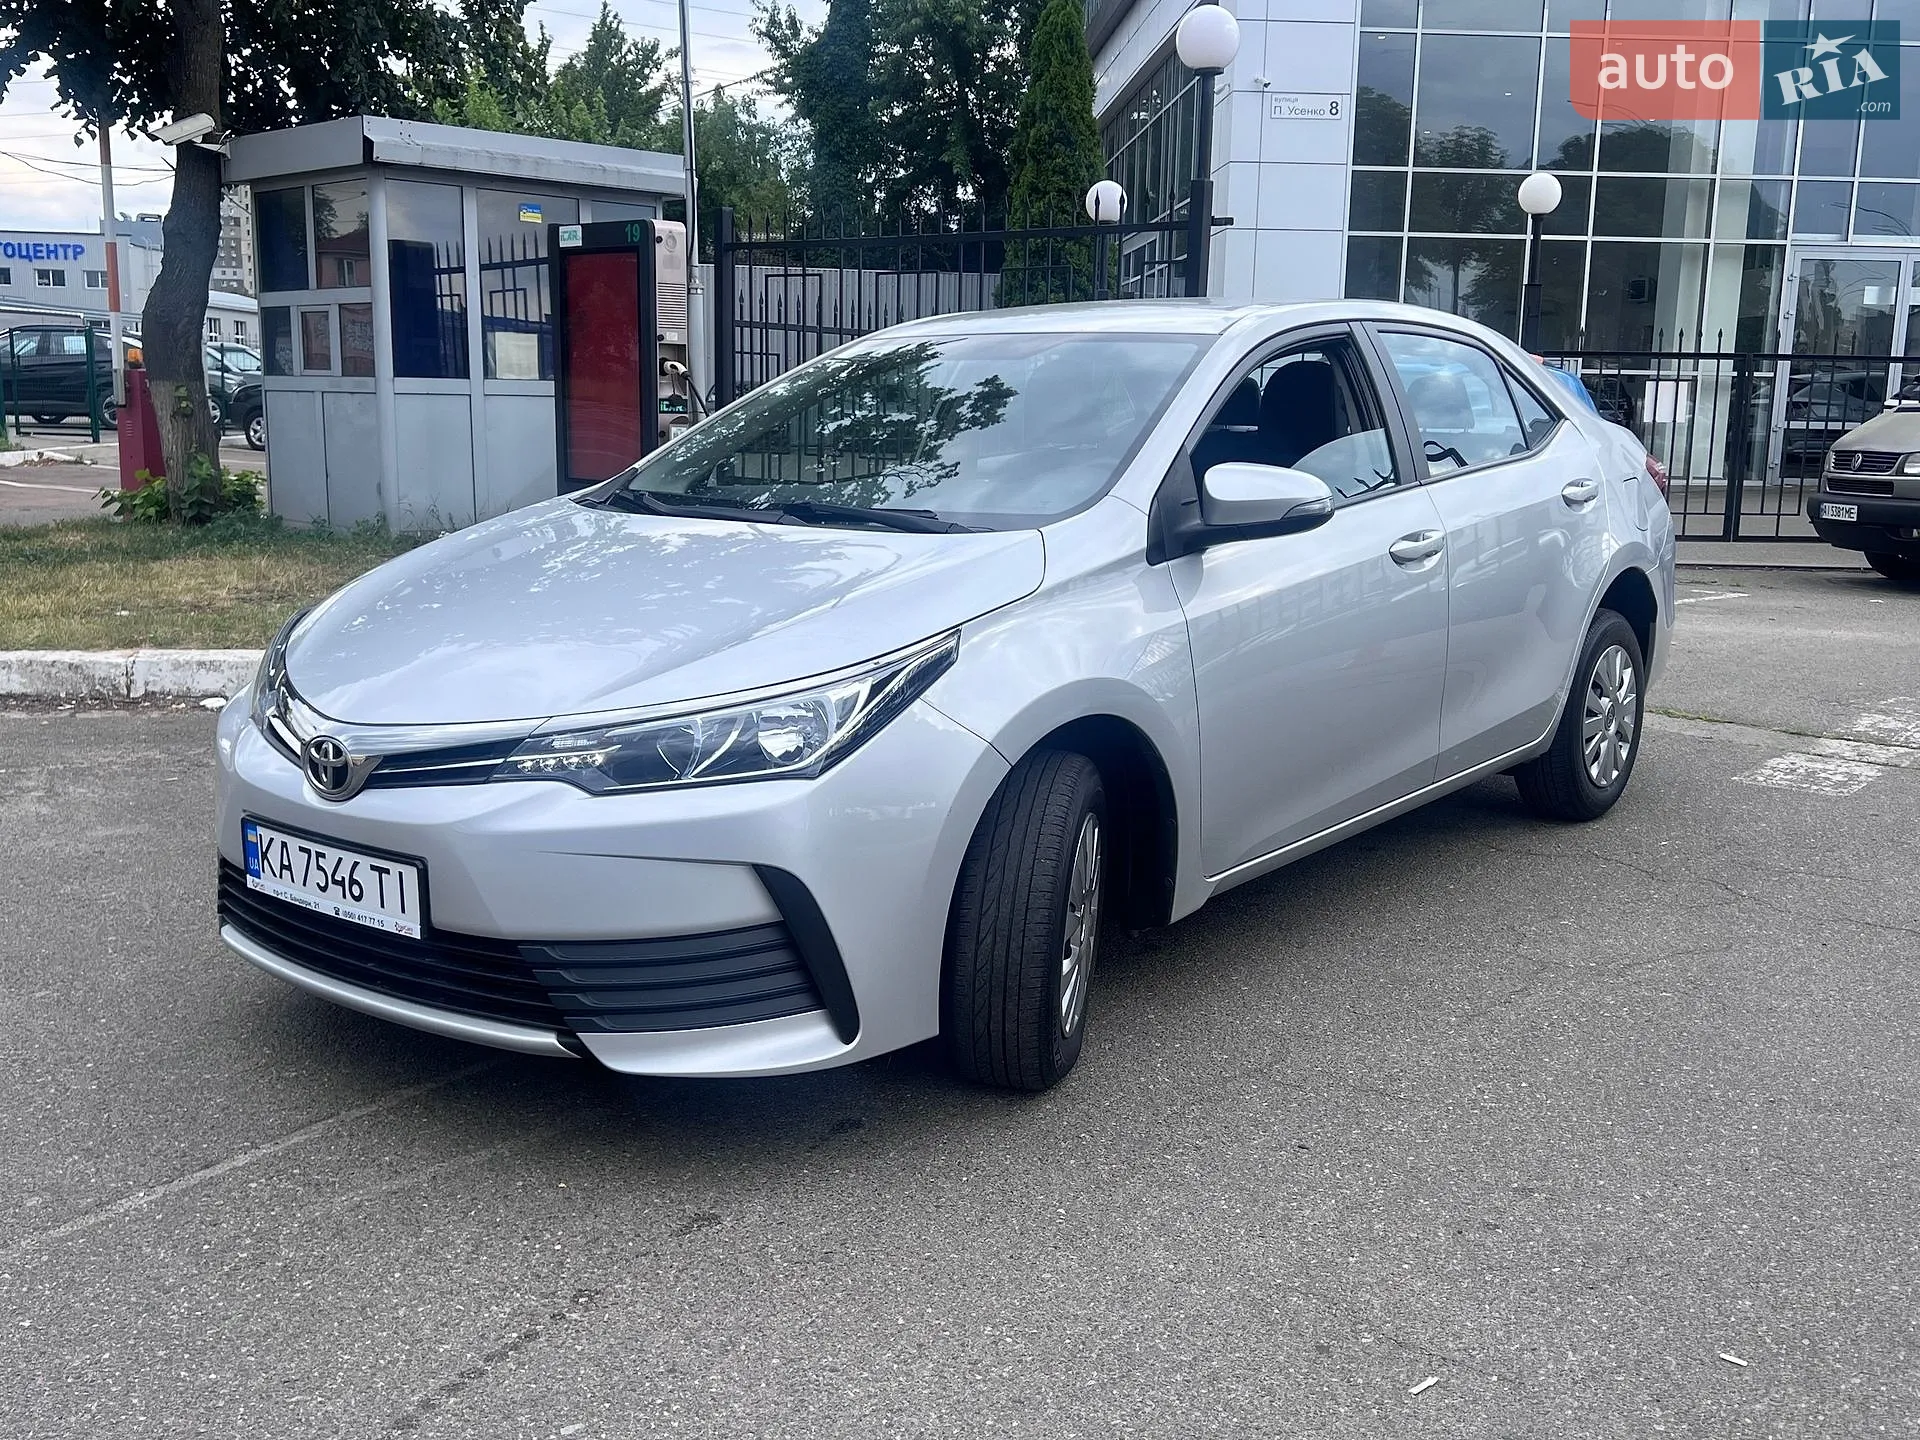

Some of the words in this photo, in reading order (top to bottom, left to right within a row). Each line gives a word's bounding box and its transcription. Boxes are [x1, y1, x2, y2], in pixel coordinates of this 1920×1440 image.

[1287, 106, 1326, 116] Усенко
[1329, 101, 1339, 116] 8
[624, 223, 641, 243] 19
[249, 856, 259, 870] UA
